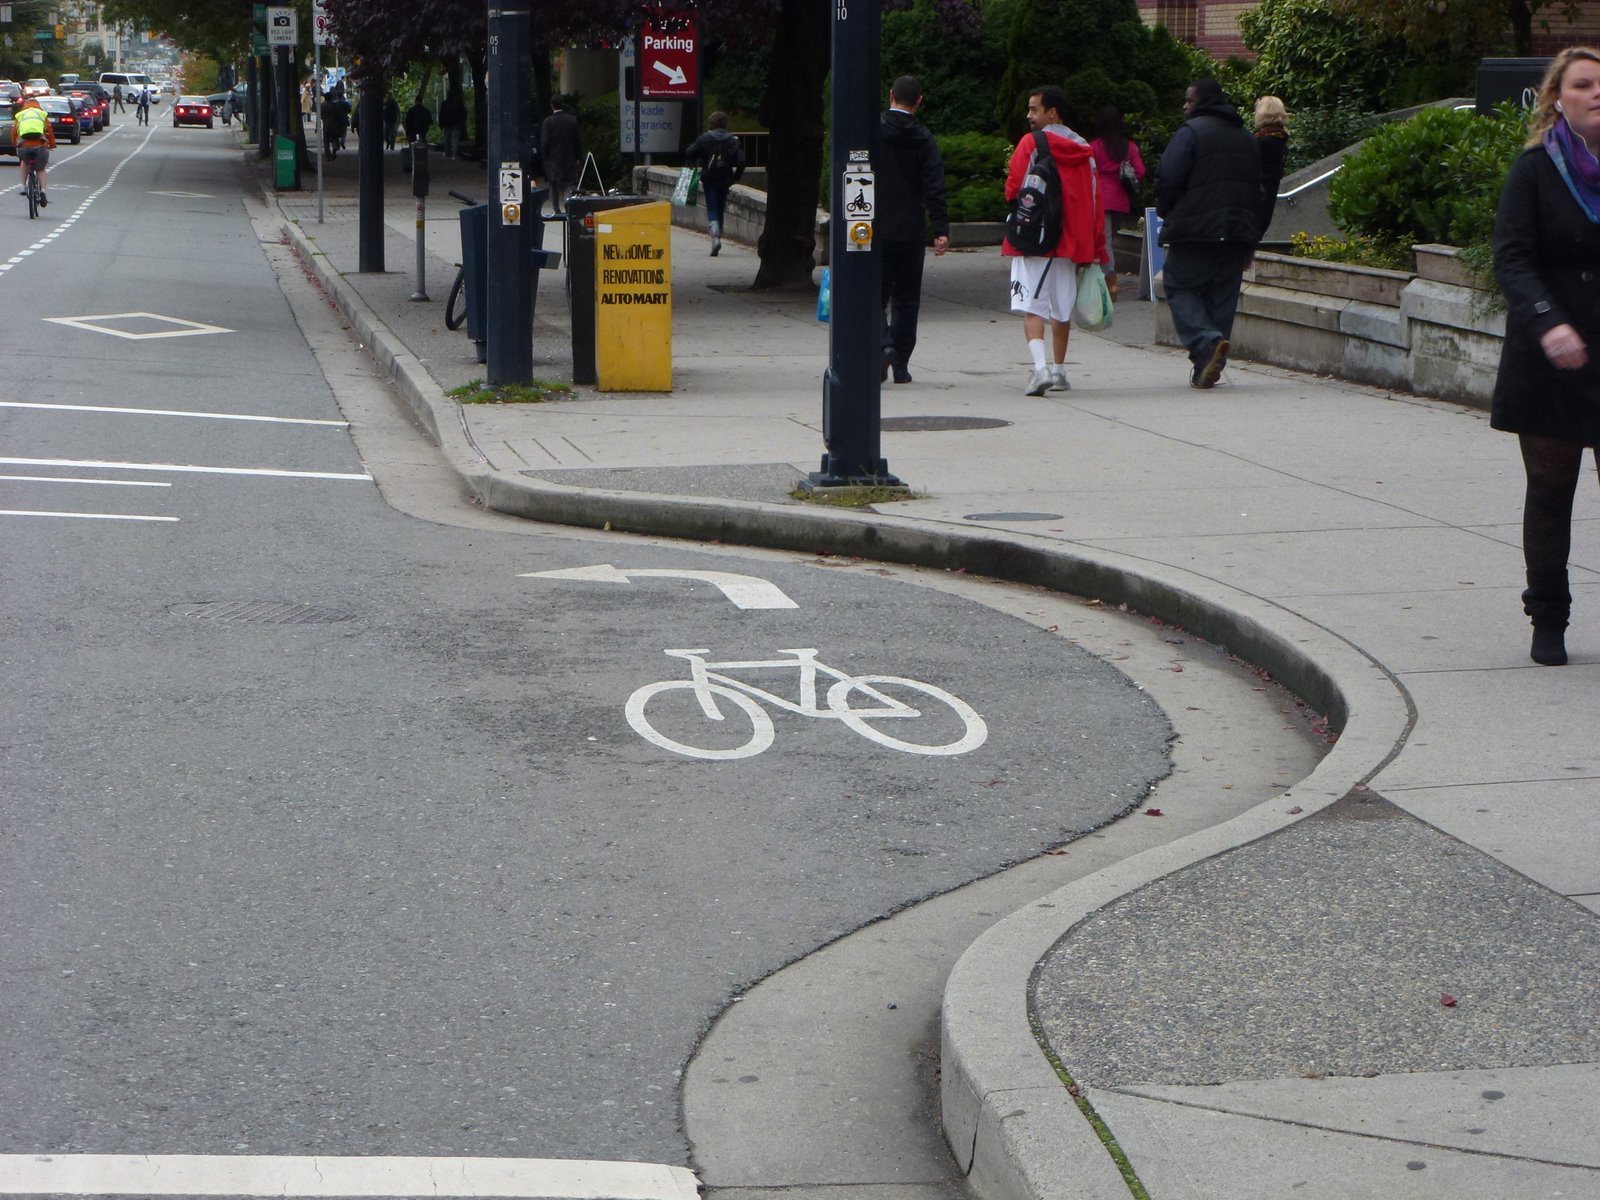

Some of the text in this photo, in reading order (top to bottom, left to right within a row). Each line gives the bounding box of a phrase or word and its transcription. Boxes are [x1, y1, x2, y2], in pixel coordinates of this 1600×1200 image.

[836, 7, 847, 20] 10
[644, 36, 693, 53] Parking
[625, 119, 673, 130] Clarance
[603, 269, 664, 285] RENOVATIONS
[601, 293, 669, 305] AUTO MART
